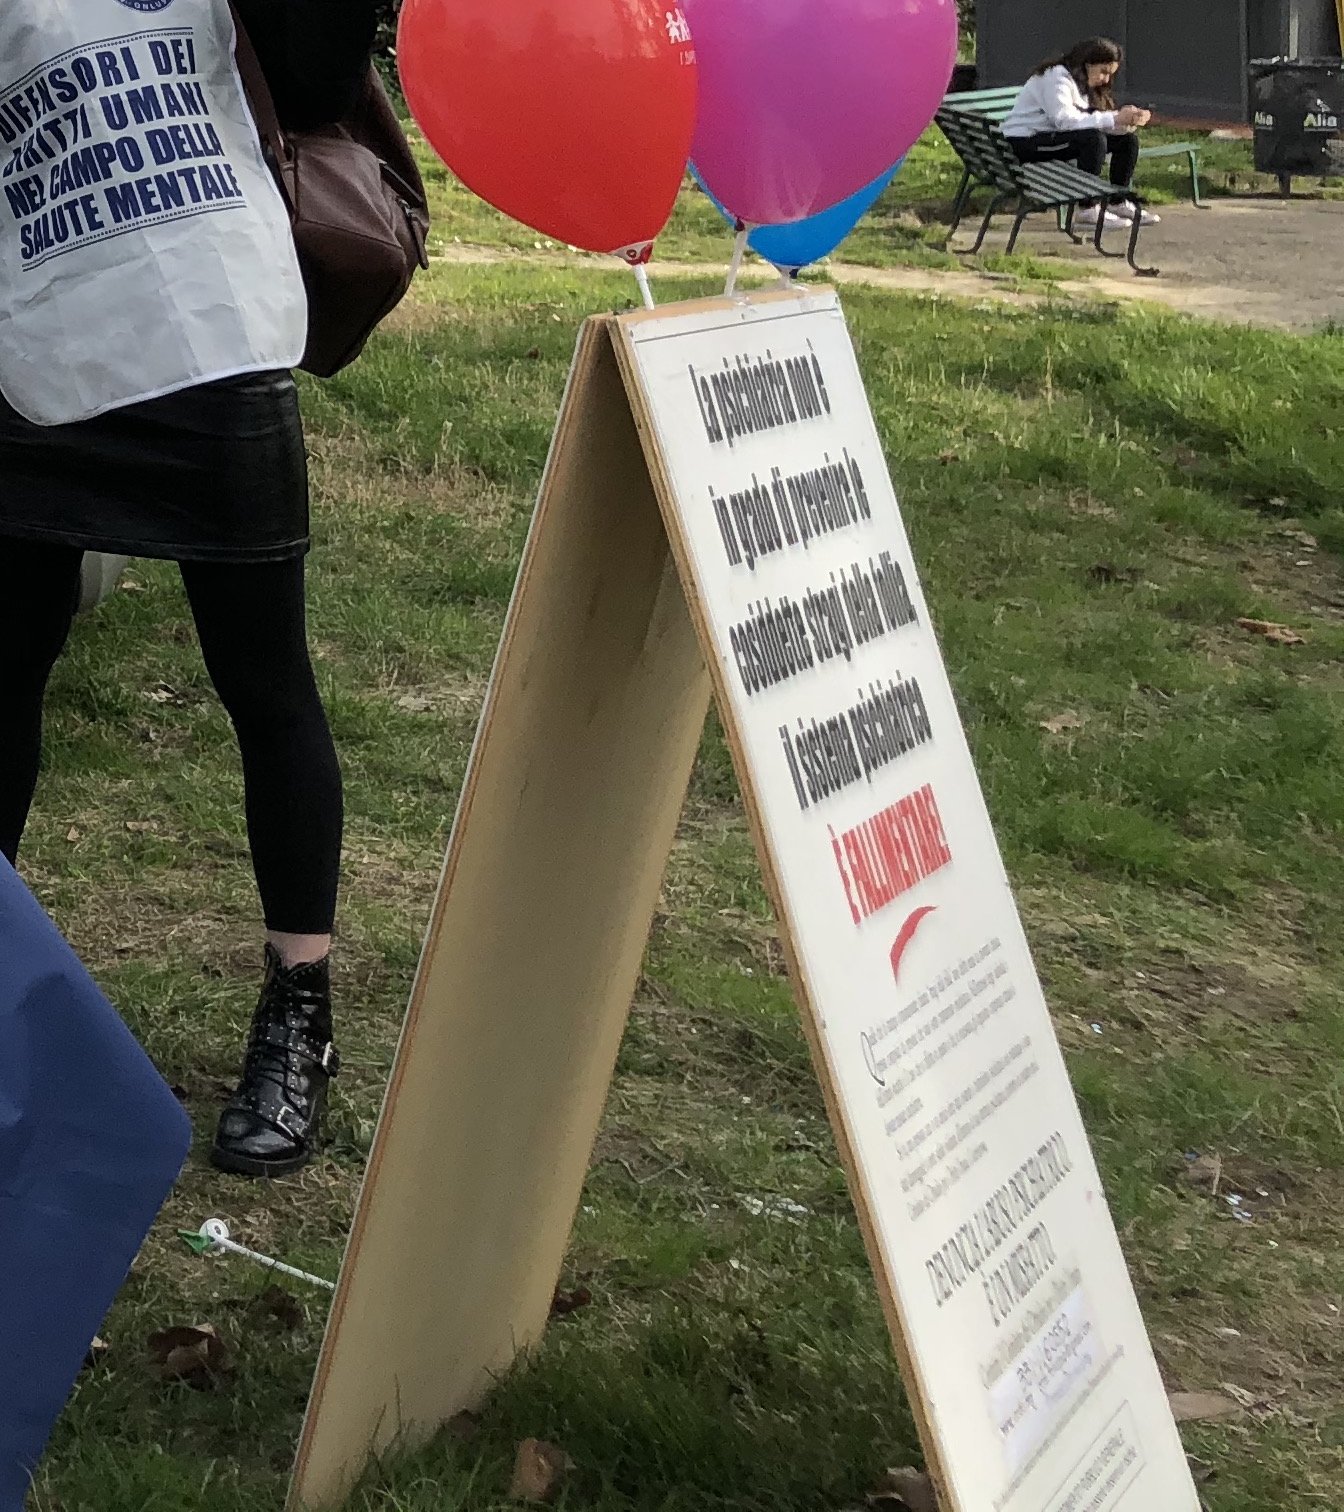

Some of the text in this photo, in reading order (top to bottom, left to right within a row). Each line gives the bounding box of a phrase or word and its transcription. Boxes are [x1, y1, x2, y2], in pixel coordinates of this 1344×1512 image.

[148, 39, 196, 76] DEI
[3, 82, 210, 178] DIRITTI UMANI
[1304, 112, 1338, 127] Alia
[4, 122, 225, 220] NEL CAMPO DELLA
[21, 163, 243, 261] SALUTE MENTALE
[688, 363, 723, 444] La
[710, 348, 798, 448] psichiatria
[785, 355, 823, 421] non
[708, 446, 871, 572] in grado di prevenire le
[728, 595, 815, 697] cosiddette
[802, 571, 855, 663] stragi
[839, 562, 885, 646] della
[778, 669, 933, 811] il sistema psichiatrico
